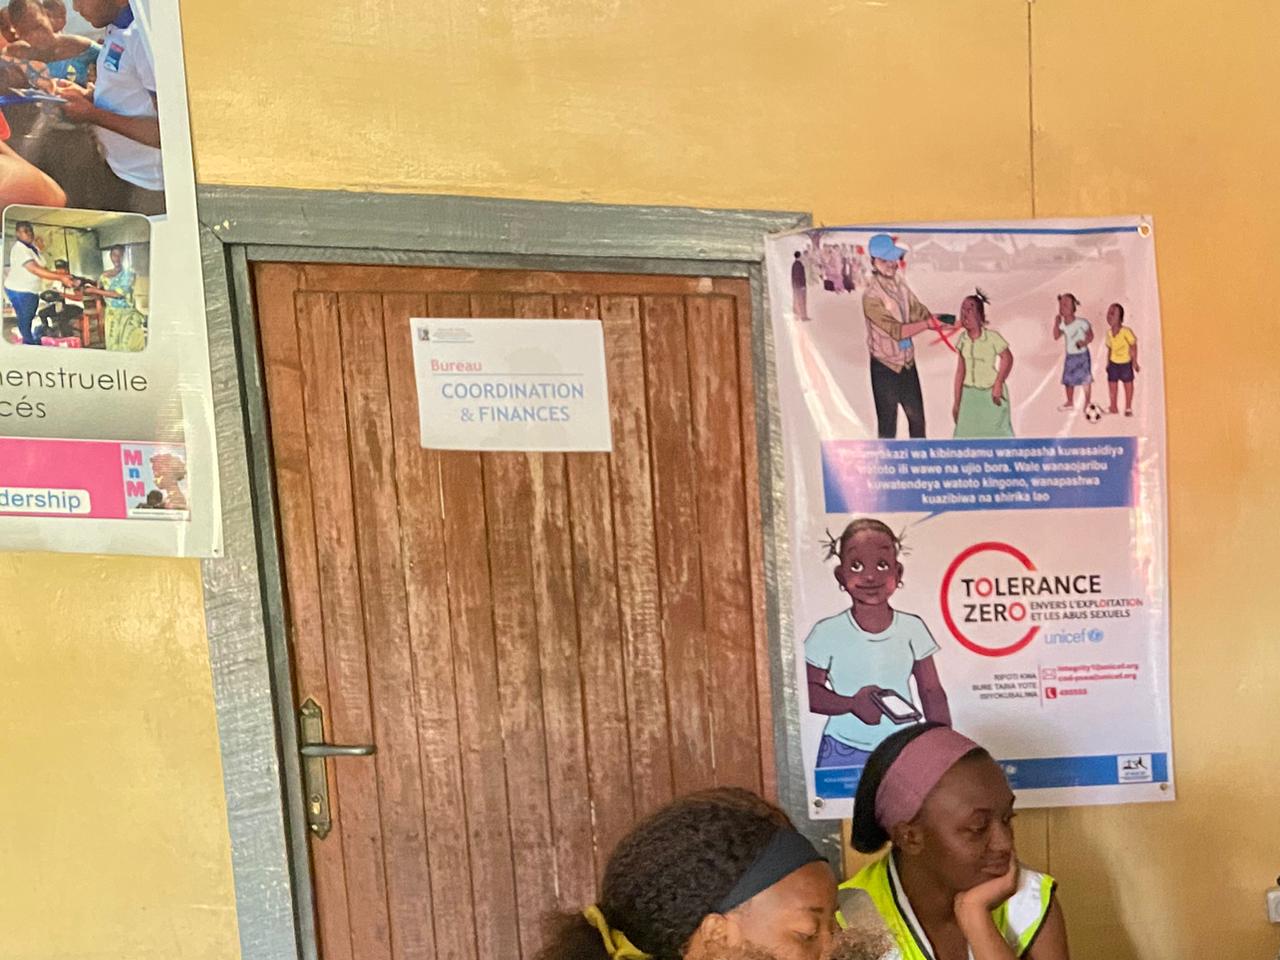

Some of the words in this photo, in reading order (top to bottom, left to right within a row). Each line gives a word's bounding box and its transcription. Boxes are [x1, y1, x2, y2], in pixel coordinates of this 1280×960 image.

[431, 359, 482, 372] Bureau
[0, 368, 148, 391] enstruelle
[442, 383, 584, 399] COORDINATION
[460, 407, 474, 422] &
[479, 406, 570, 422] FINANCES
[945, 465, 959, 474] na
[943, 480, 980, 489] watoto
[961, 575, 1101, 597] TOLERANCE
[1030, 601, 1067, 610] ENVERS
[1069, 598, 1143, 609] L'EXPLOITATION
[964, 602, 1026, 622] ZERO
[1031, 612, 1042, 621] ET
[1044, 611, 1060, 621] LES
[1063, 611, 1088, 620] ABUS
[1090, 609, 1130, 619] SEXUELS
[1045, 629, 1086, 644] unicef
